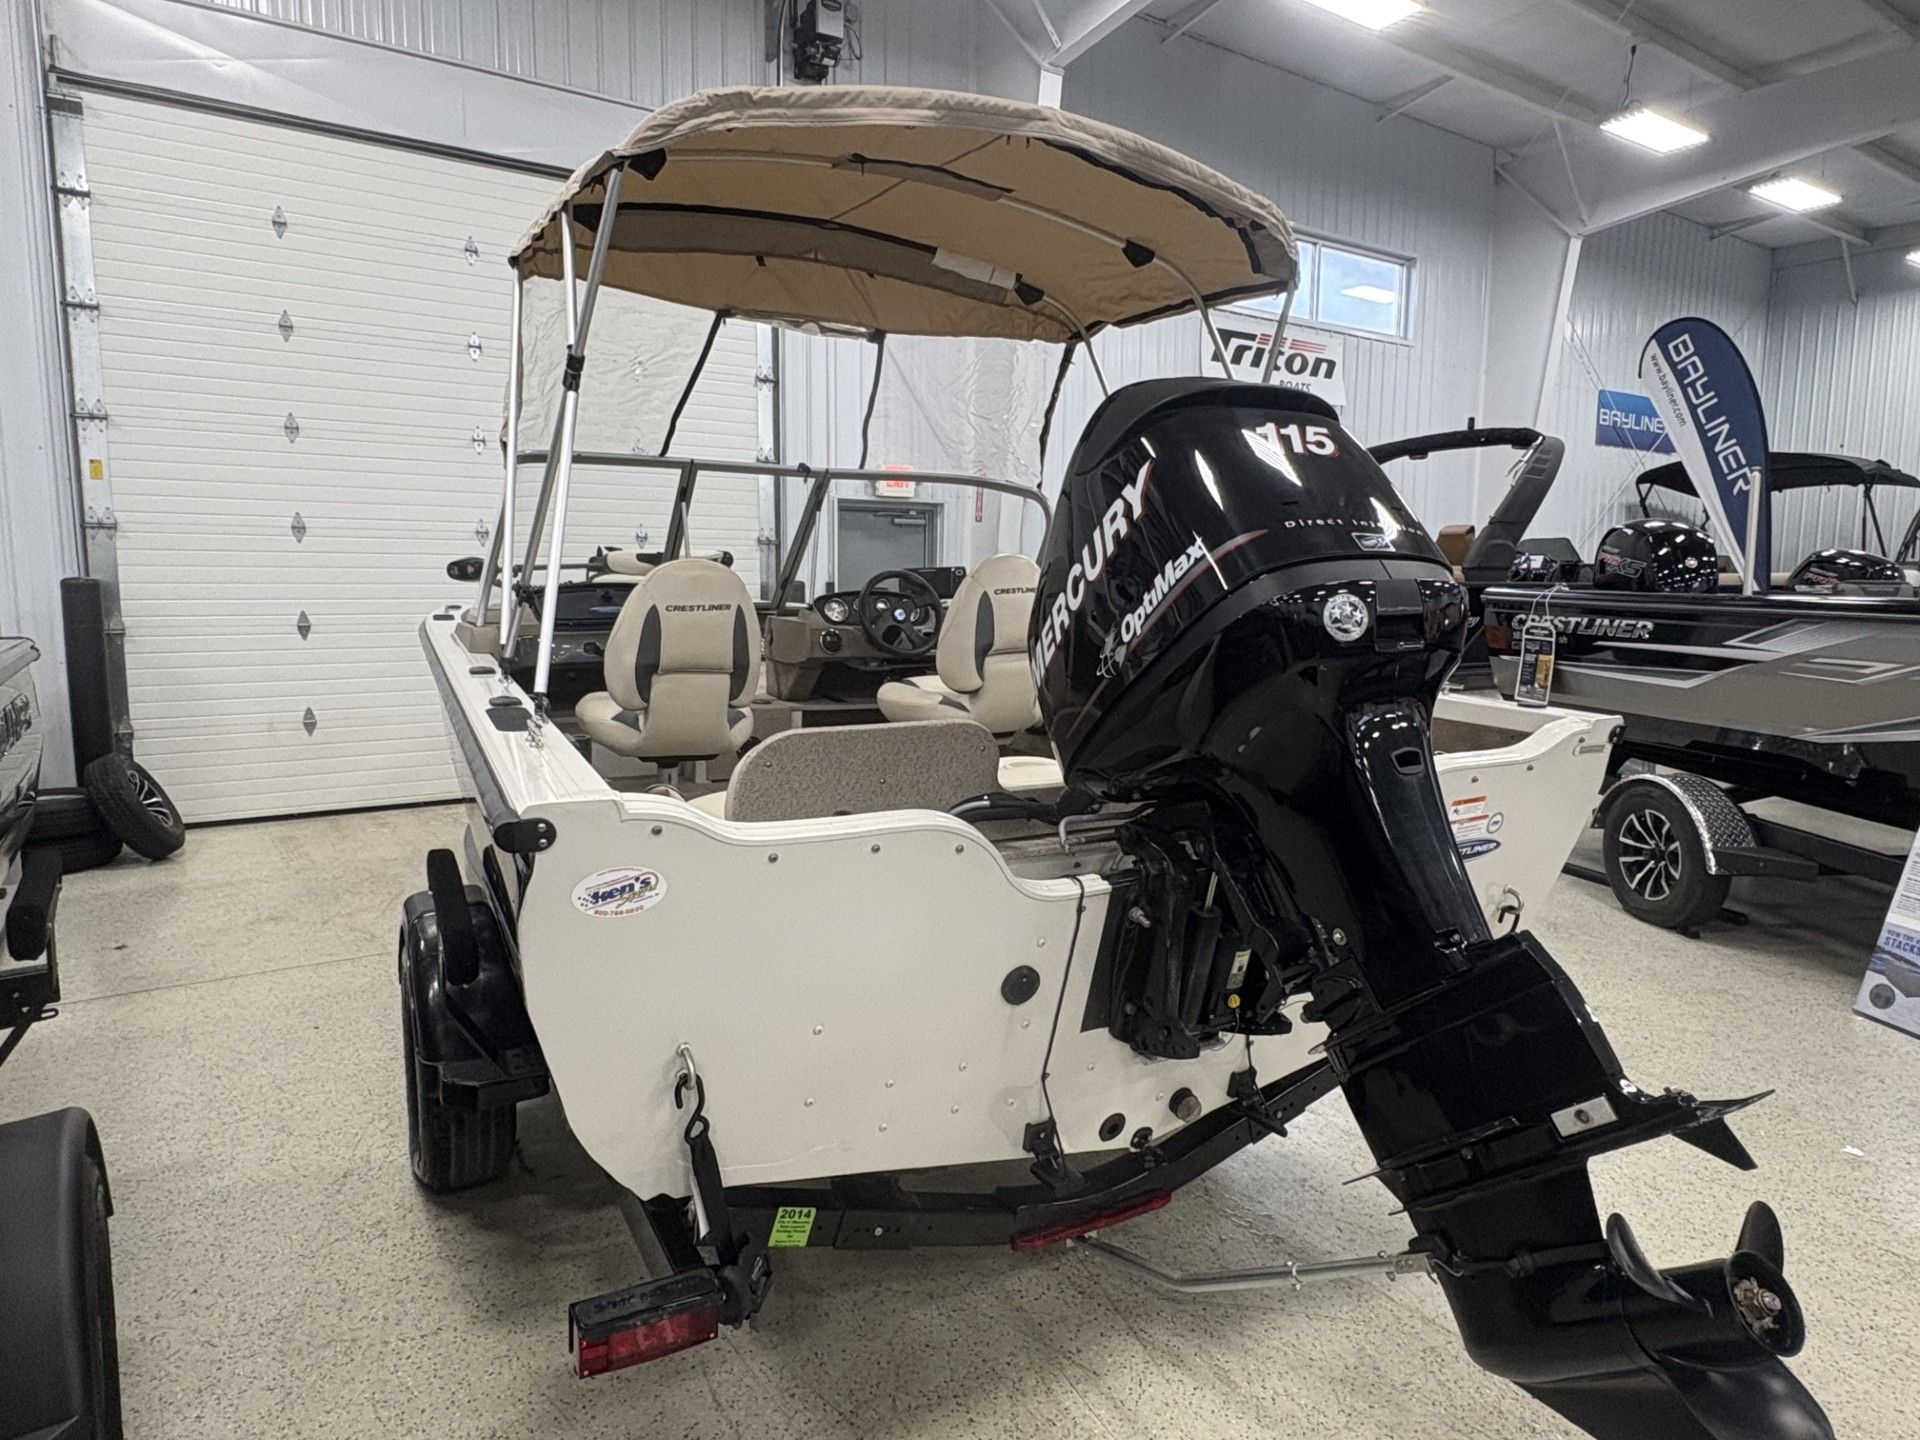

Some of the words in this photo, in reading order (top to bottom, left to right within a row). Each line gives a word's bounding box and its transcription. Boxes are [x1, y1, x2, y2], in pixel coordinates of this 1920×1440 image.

[1650, 352, 1687, 428] www.bayliner.com
[1599, 408, 1665, 433] BAYLINE
[1668, 333, 1751, 496] BAYLINER
[1255, 422, 1336, 457] 115
[1284, 518, 1344, 529] Direct
[1032, 458, 1153, 688] MERCURY
[1120, 537, 1206, 643] OptiMax
[664, 603, 732, 613] CRESTLINER
[1511, 614, 1655, 640] CRESTLINER
[779, 1209, 811, 1219] 2014
